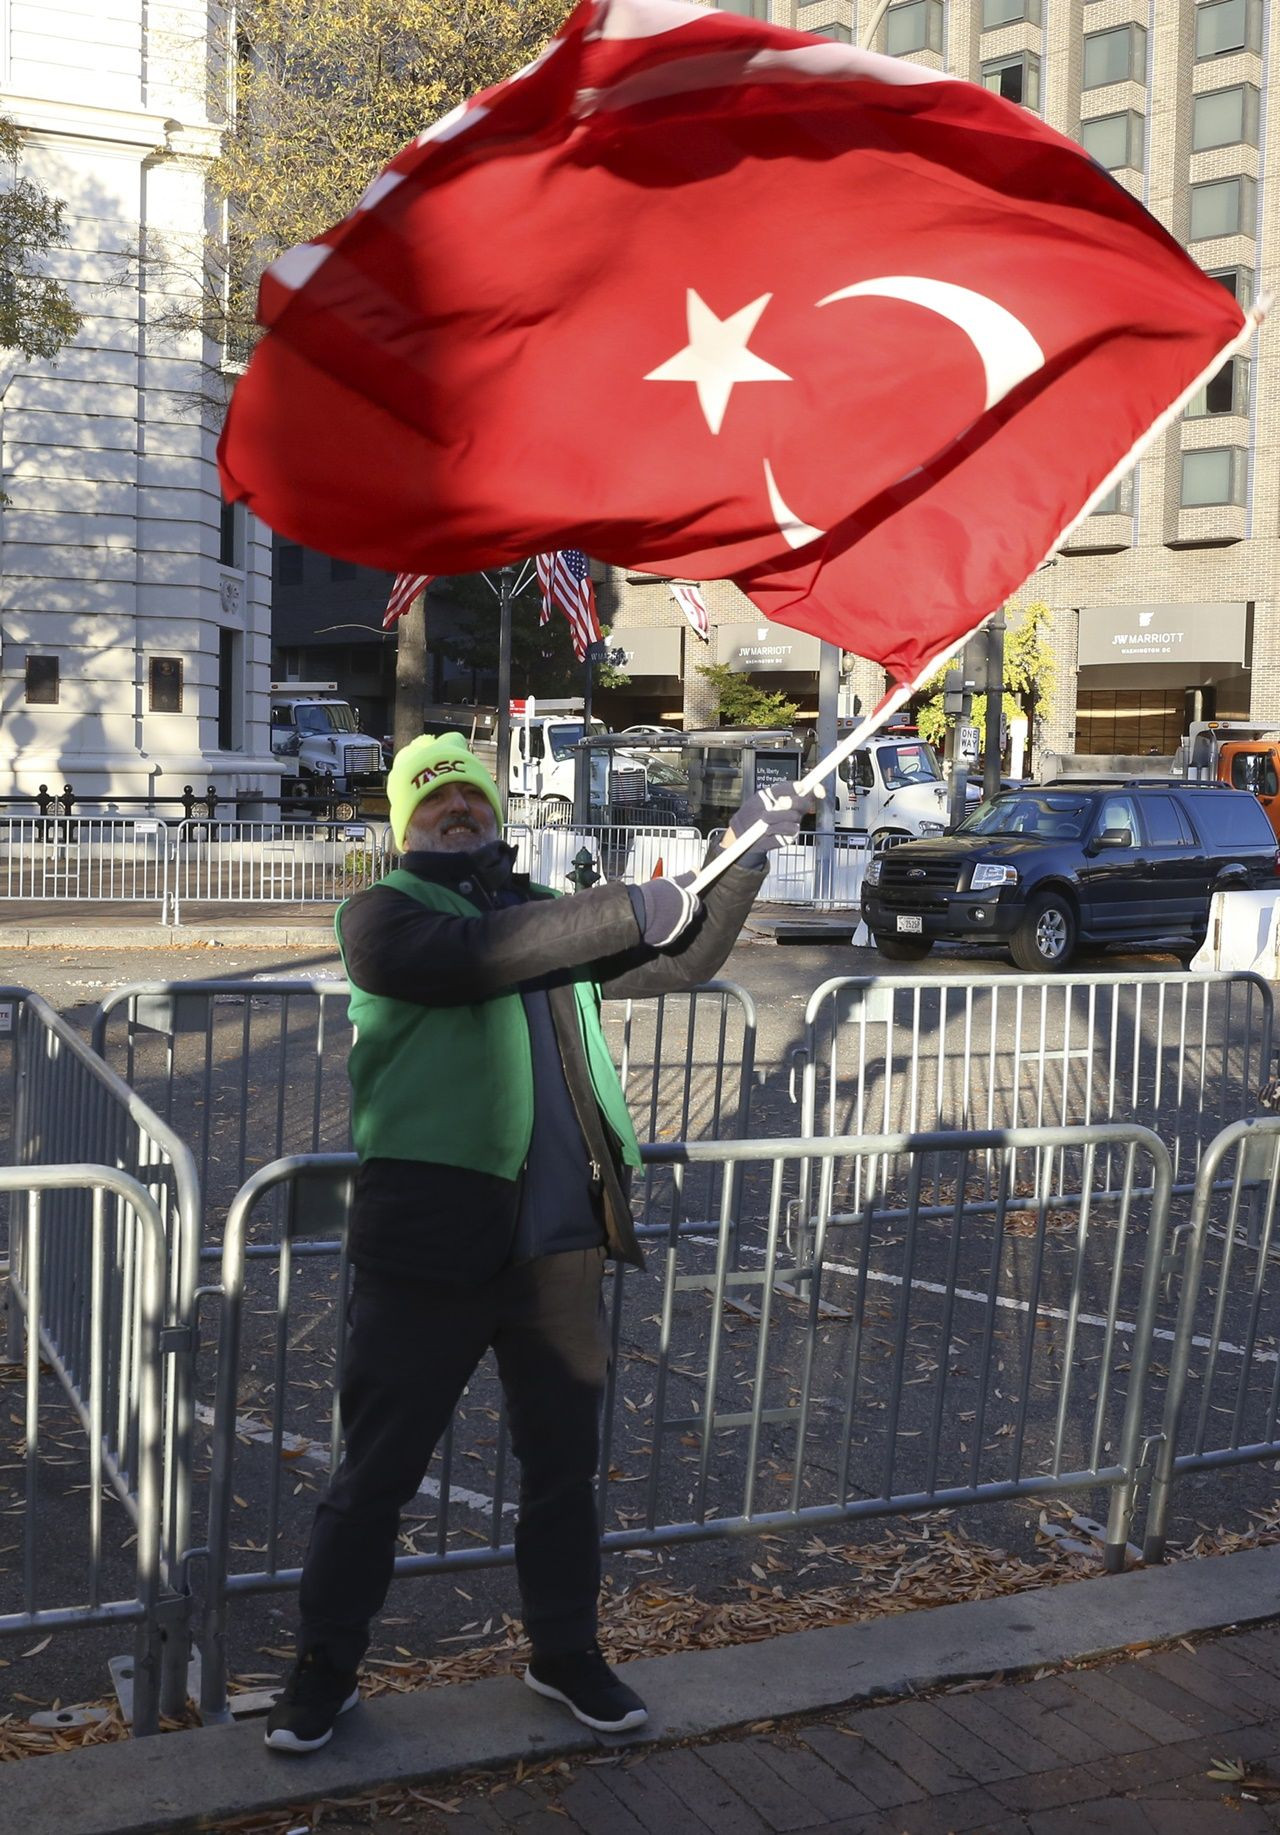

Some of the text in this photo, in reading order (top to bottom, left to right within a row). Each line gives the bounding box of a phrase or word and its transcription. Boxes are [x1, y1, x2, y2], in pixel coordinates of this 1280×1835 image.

[1112, 632, 1184, 645] JW MARRIOTT
[739, 645, 792, 656] JW MARRIOTT
[962, 729, 977, 739] ONE
[962, 739, 978, 748] WAY
[411, 760, 466, 790] TASC
